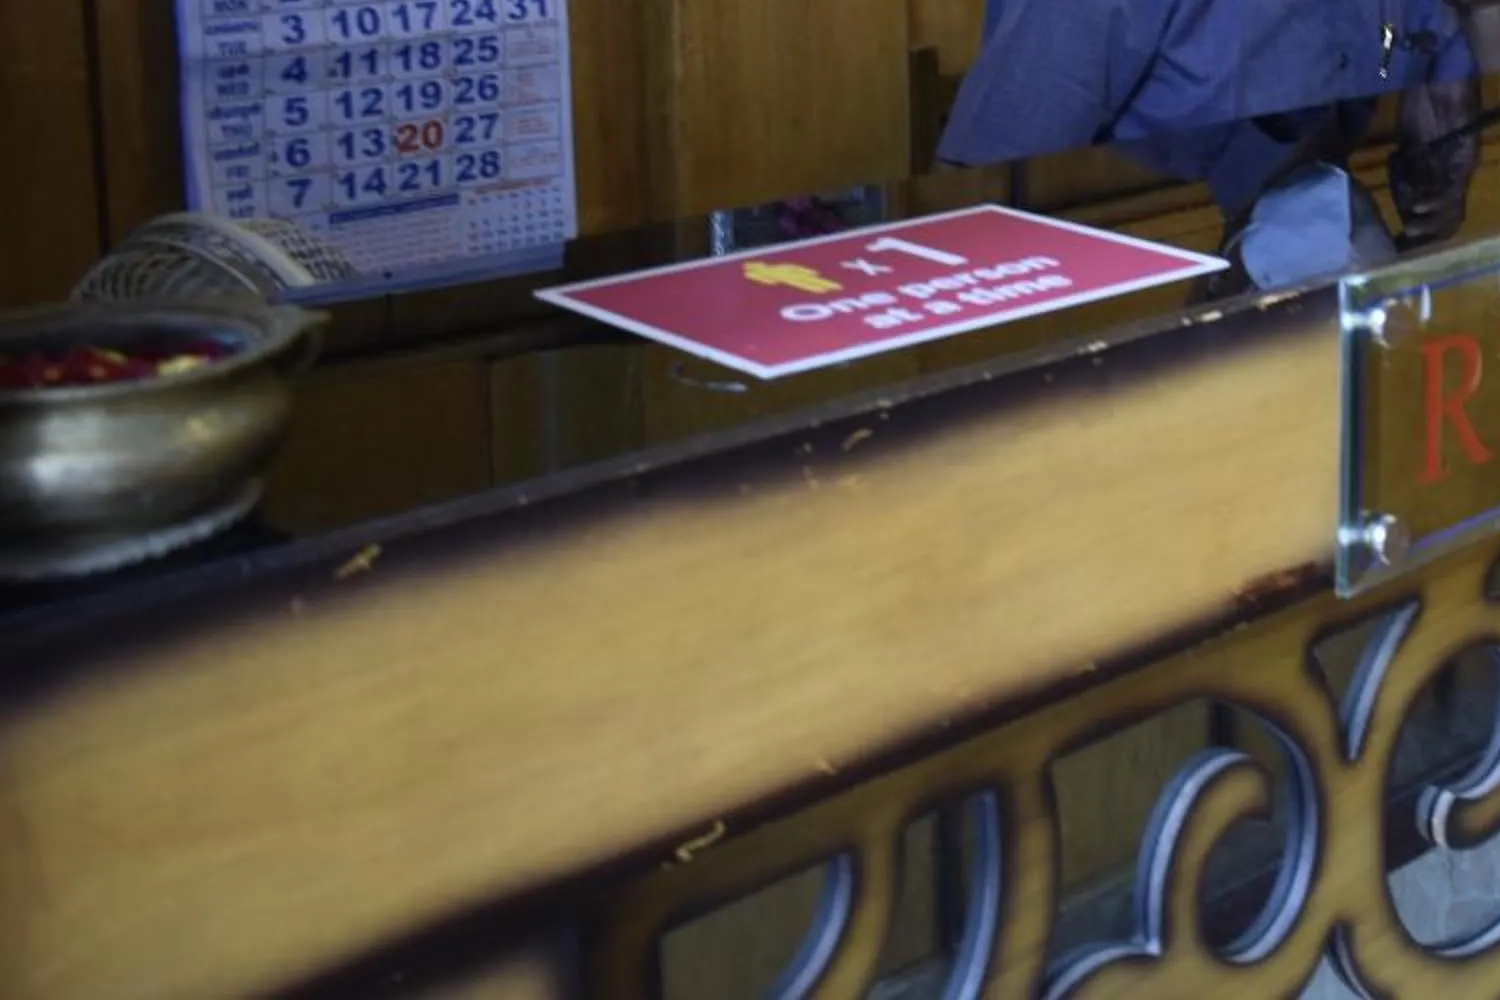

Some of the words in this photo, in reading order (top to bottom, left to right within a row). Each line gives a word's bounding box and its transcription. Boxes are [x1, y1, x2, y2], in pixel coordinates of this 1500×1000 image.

[281, 14, 306, 44] 3
[330, 6, 380, 38] 10
[392, 2, 437, 32] 17
[281, 56, 308, 84] 4
[335, 48, 379, 79] 11
[395, 42, 440, 72] 18
[452, 36, 498, 66] 25
[283, 96, 309, 126] 5
[334, 87, 384, 120] 12
[396, 81, 441, 112] 19
[452, 74, 498, 105] 26
[286, 138, 311, 168] 6
[336, 128, 386, 160] 13
[396, 120, 443, 152] 20
[454, 113, 499, 144] 27
[286, 178, 313, 208] 7
[337, 167, 386, 200] 14
[398, 159, 441, 191] 21
[456, 151, 501, 182] 28
[864, 236, 969, 266] 1
[779, 290, 898, 321] One
[897, 255, 1060, 299] person
[863, 306, 924, 329] at
[923, 300, 962, 316] a
[956, 273, 1073, 305] time
